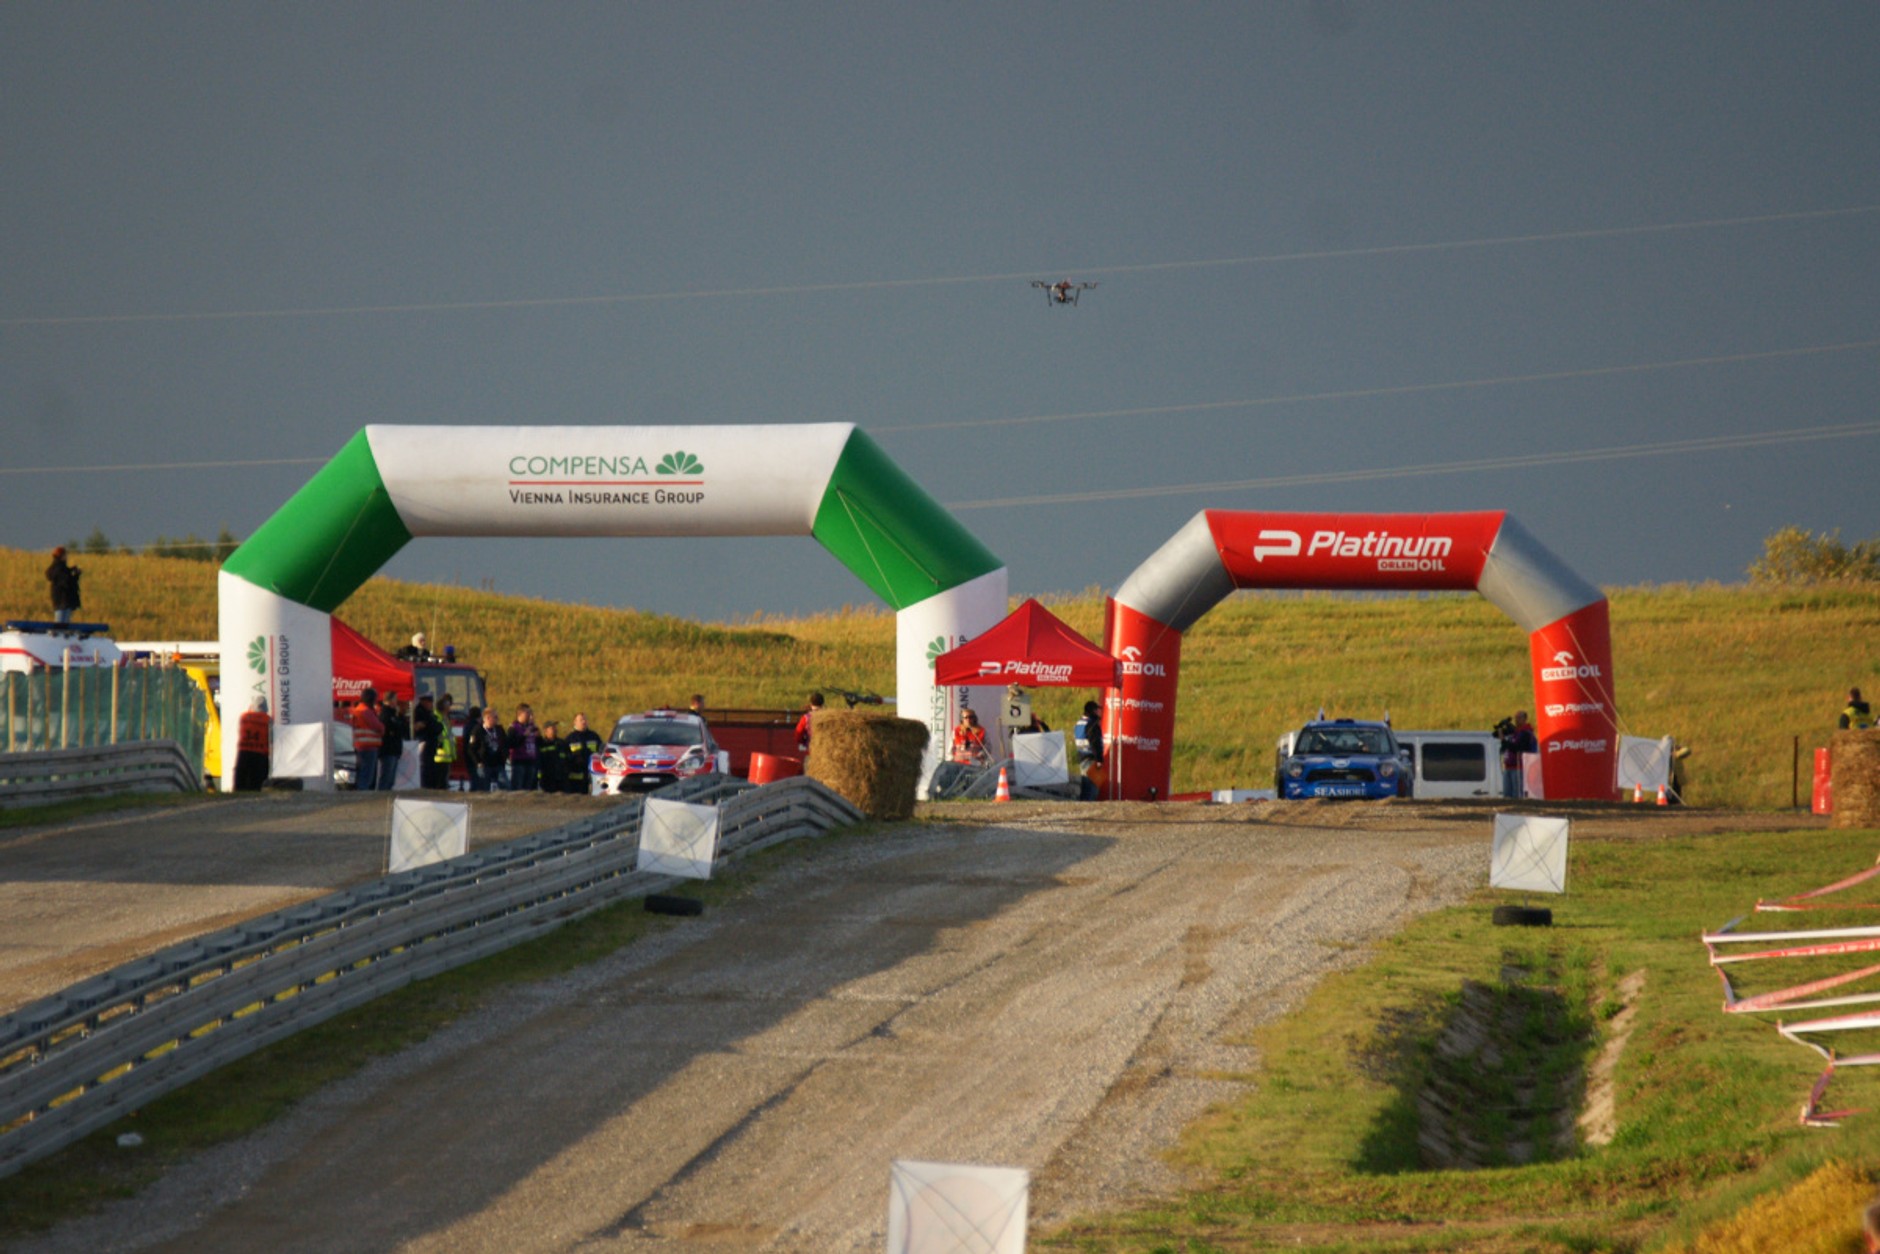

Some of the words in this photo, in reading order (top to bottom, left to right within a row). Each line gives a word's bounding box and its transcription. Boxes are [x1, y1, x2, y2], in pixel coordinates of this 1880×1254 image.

[509, 456, 649, 475] COMPENSA
[509, 489, 564, 504] VIENNA
[568, 489, 650, 504] INSURANCE
[654, 488, 705, 504] GROUP
[1307, 531, 1453, 557] Platinum
[1419, 559, 1446, 572] OIL
[1004, 661, 1073, 675] Platinum
[1143, 663, 1166, 677] OIL
[1578, 665, 1602, 678] OIL
